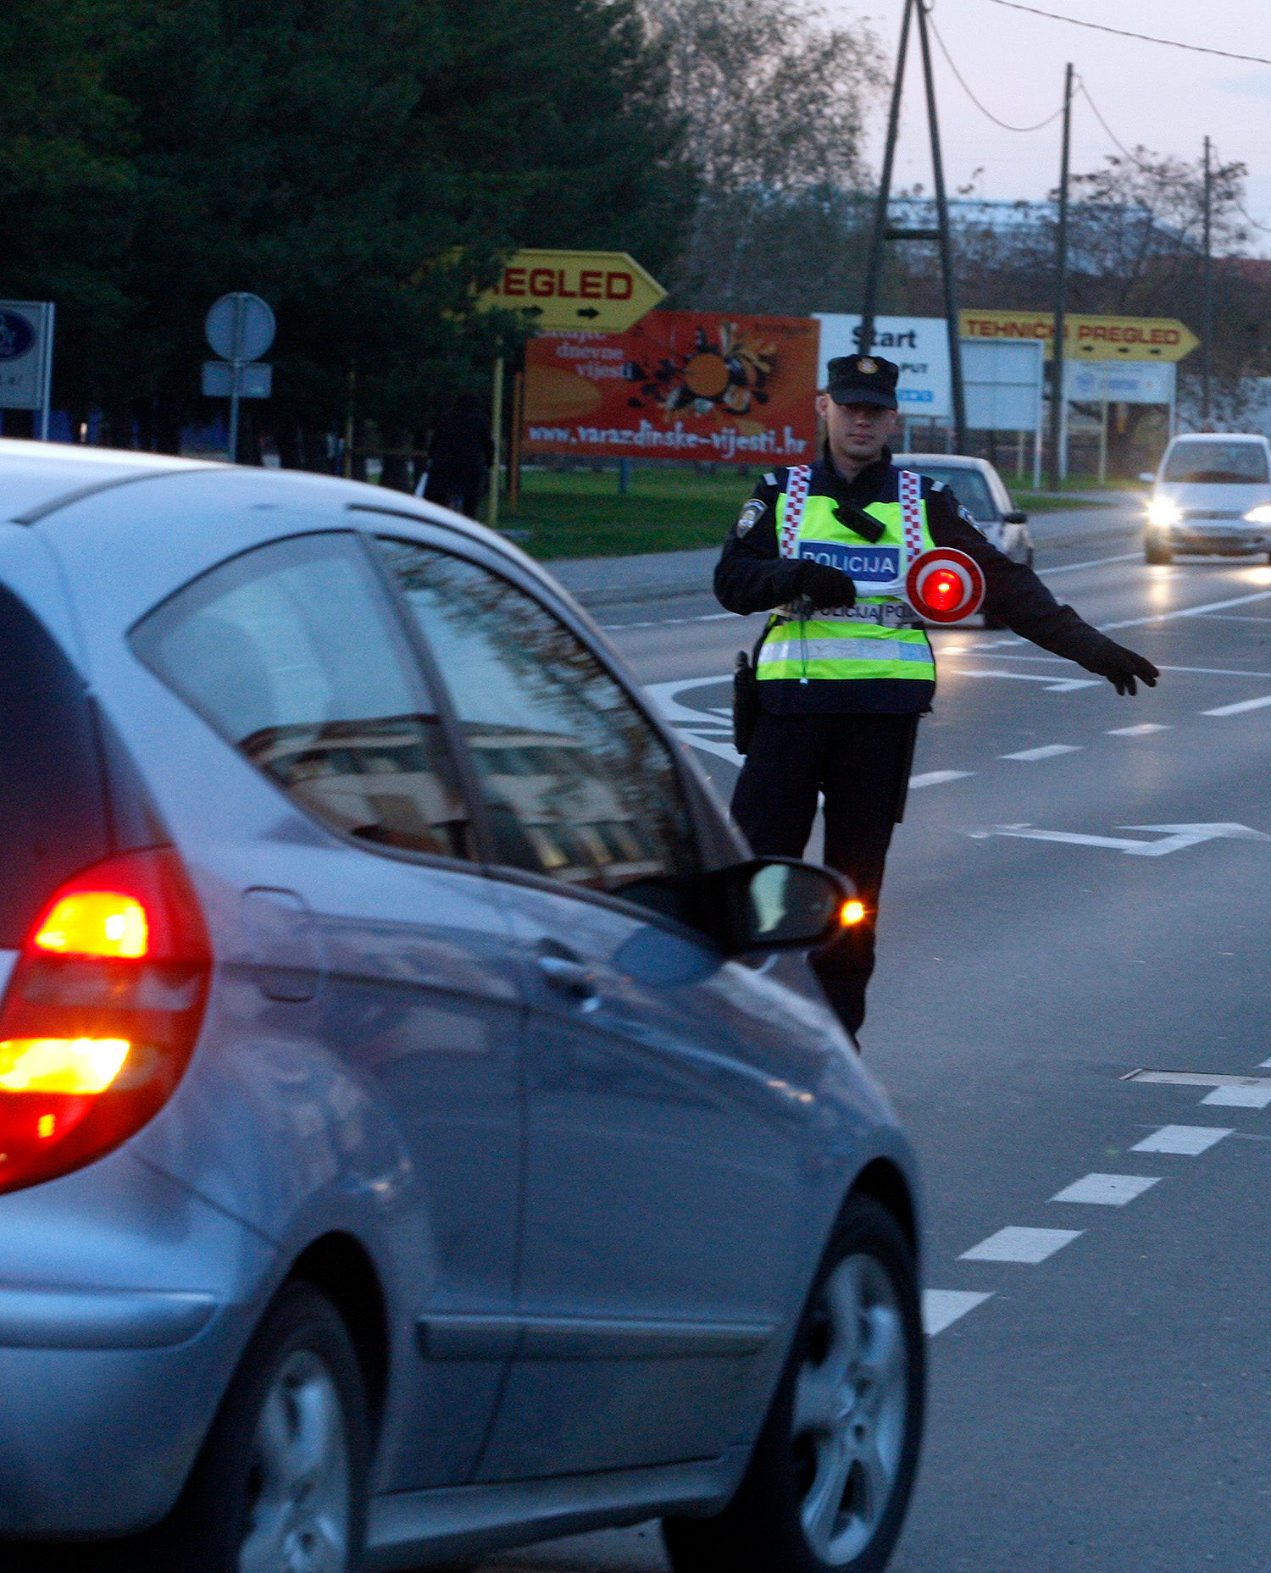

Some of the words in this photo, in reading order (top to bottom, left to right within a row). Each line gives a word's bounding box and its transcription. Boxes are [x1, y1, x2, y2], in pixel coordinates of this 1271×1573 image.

[499, 267, 634, 300] EGLED
[1078, 325, 1180, 345] PREGLED
[555, 342, 624, 360] dnevne
[576, 361, 633, 380] vijesti
[528, 418, 807, 458] www.varazdinske-vijesti.hr
